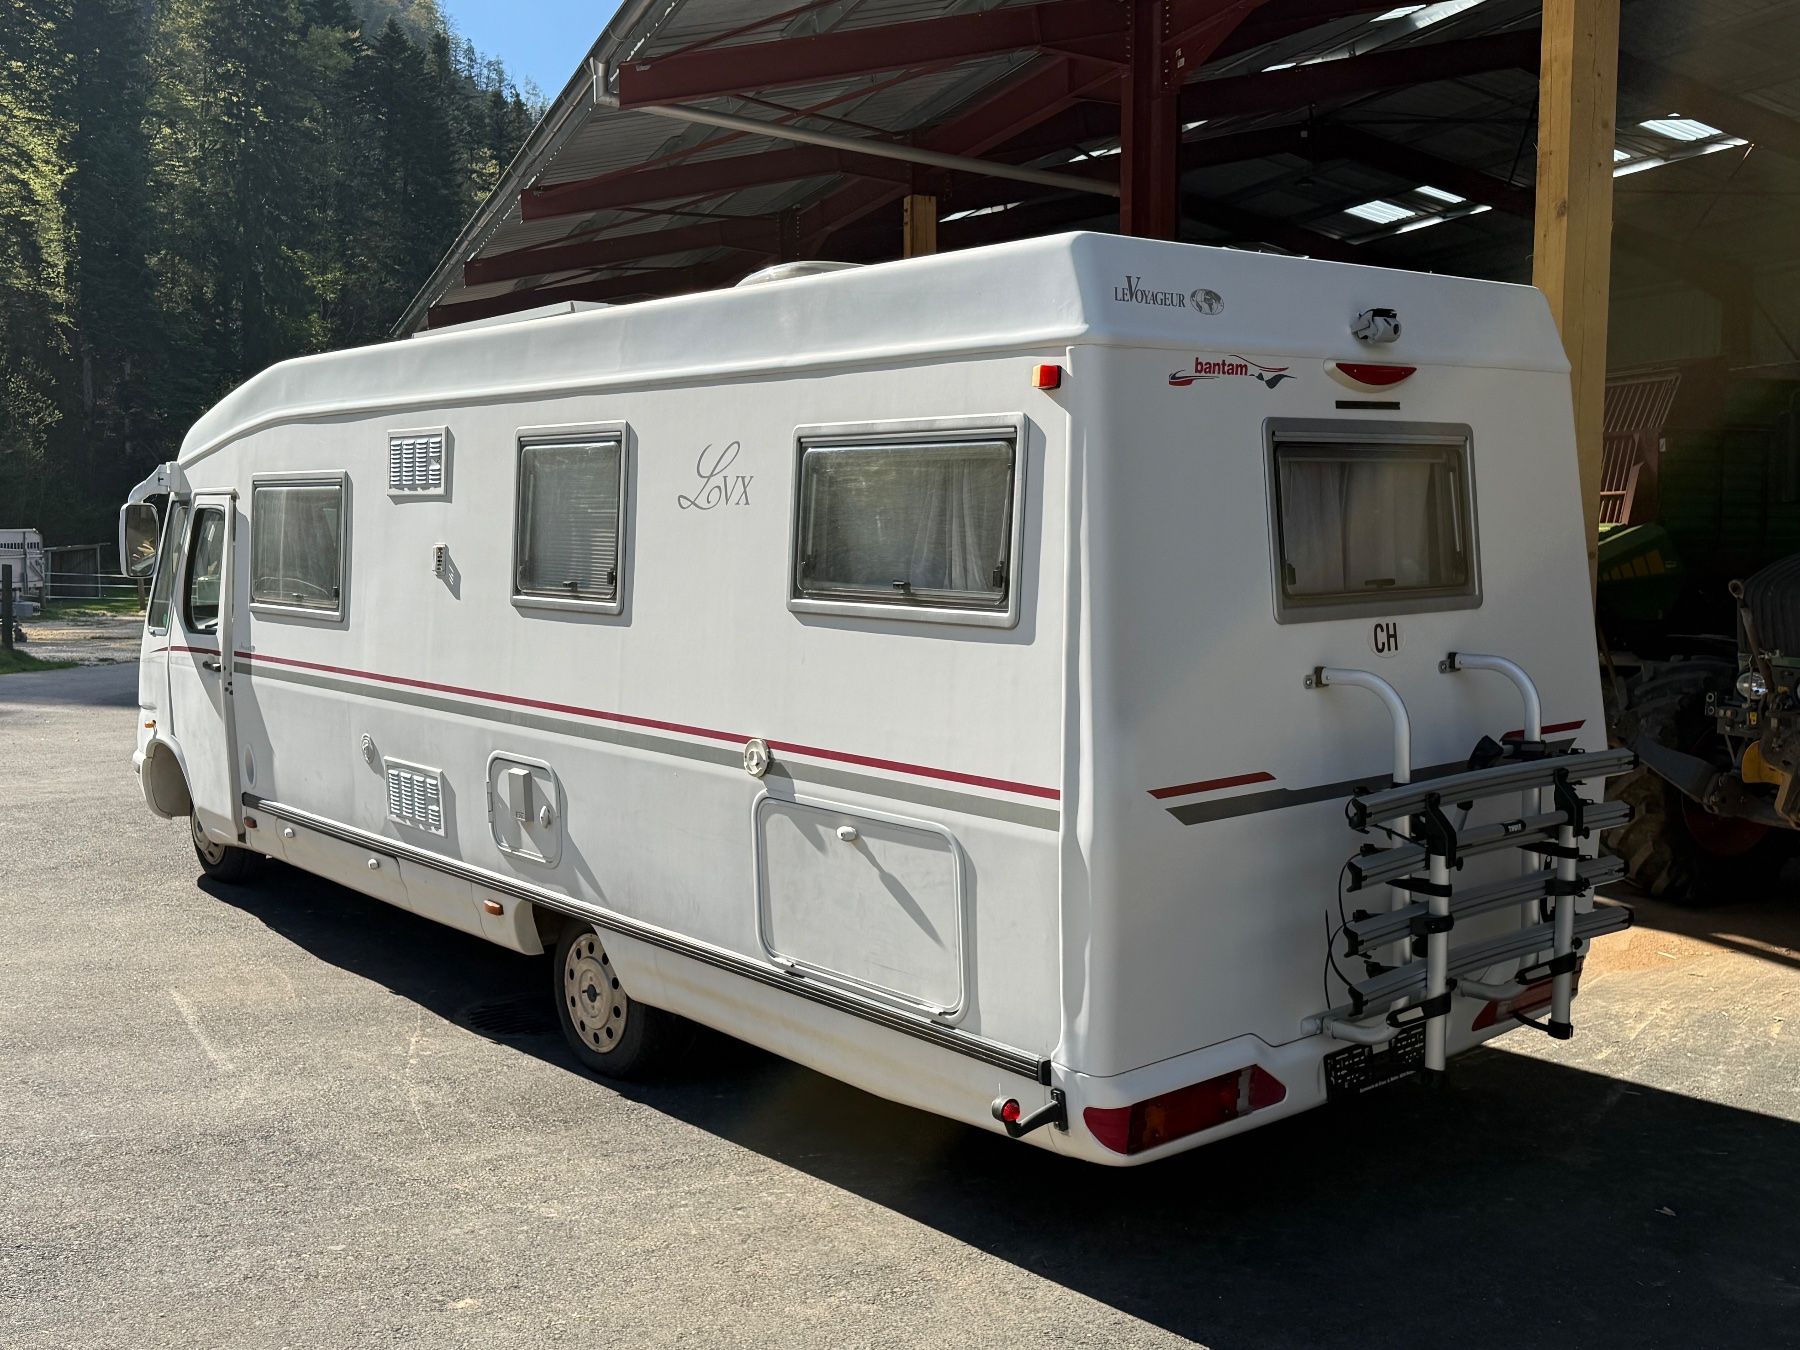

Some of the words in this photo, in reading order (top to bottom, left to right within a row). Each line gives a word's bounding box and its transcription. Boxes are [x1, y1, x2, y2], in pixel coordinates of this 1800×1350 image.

[1195, 357, 1248, 376] bantam
[678, 441, 754, 510] LVX
[1374, 622, 1399, 653] CH
